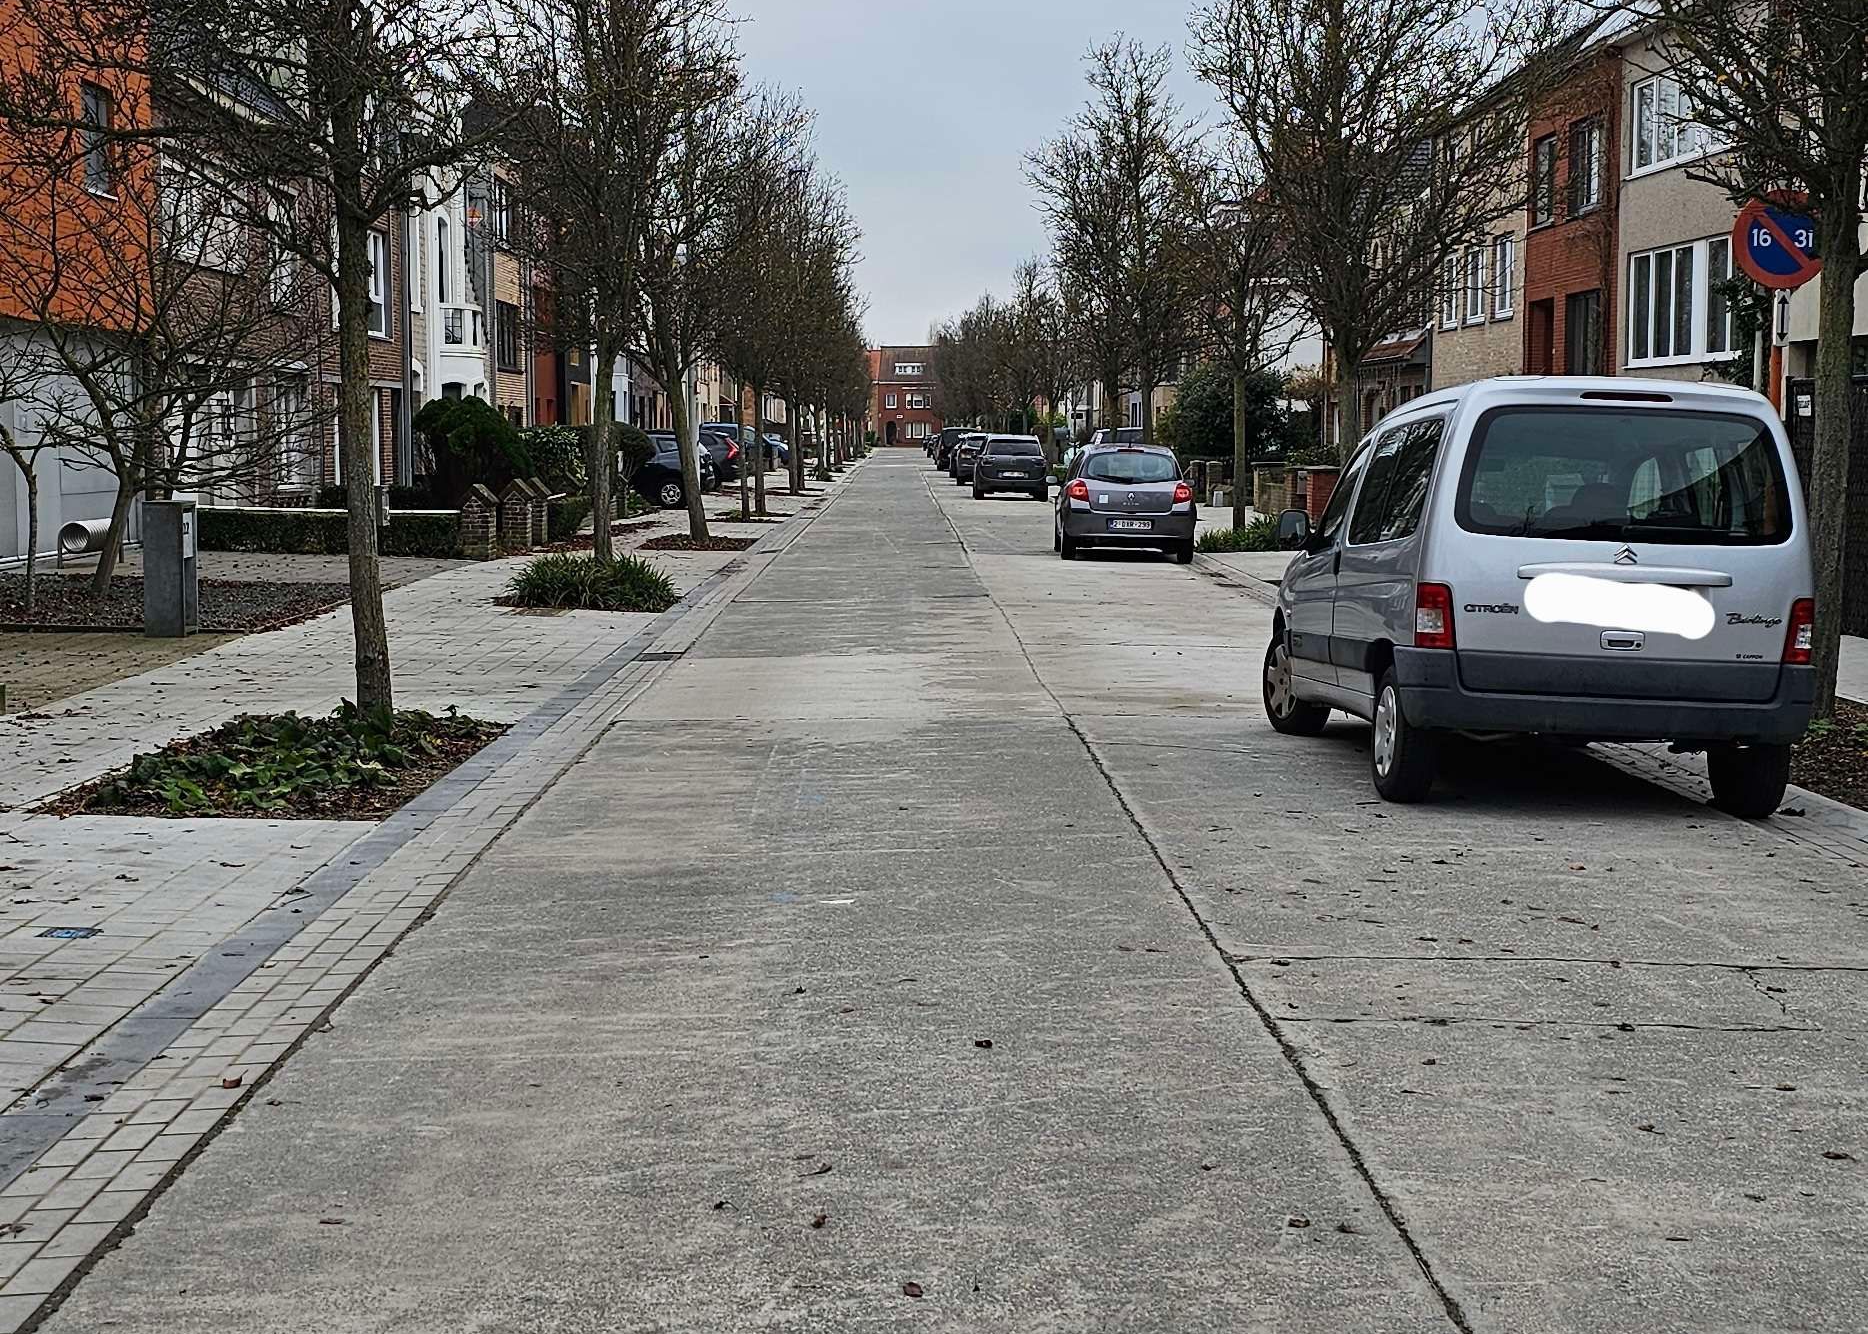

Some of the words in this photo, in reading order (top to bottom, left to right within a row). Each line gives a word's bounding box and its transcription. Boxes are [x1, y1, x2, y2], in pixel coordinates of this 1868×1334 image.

[1751, 228, 1772, 247] 16
[1793, 229, 1814, 248] 31
[1726, 612, 1783, 629] Berlingo
